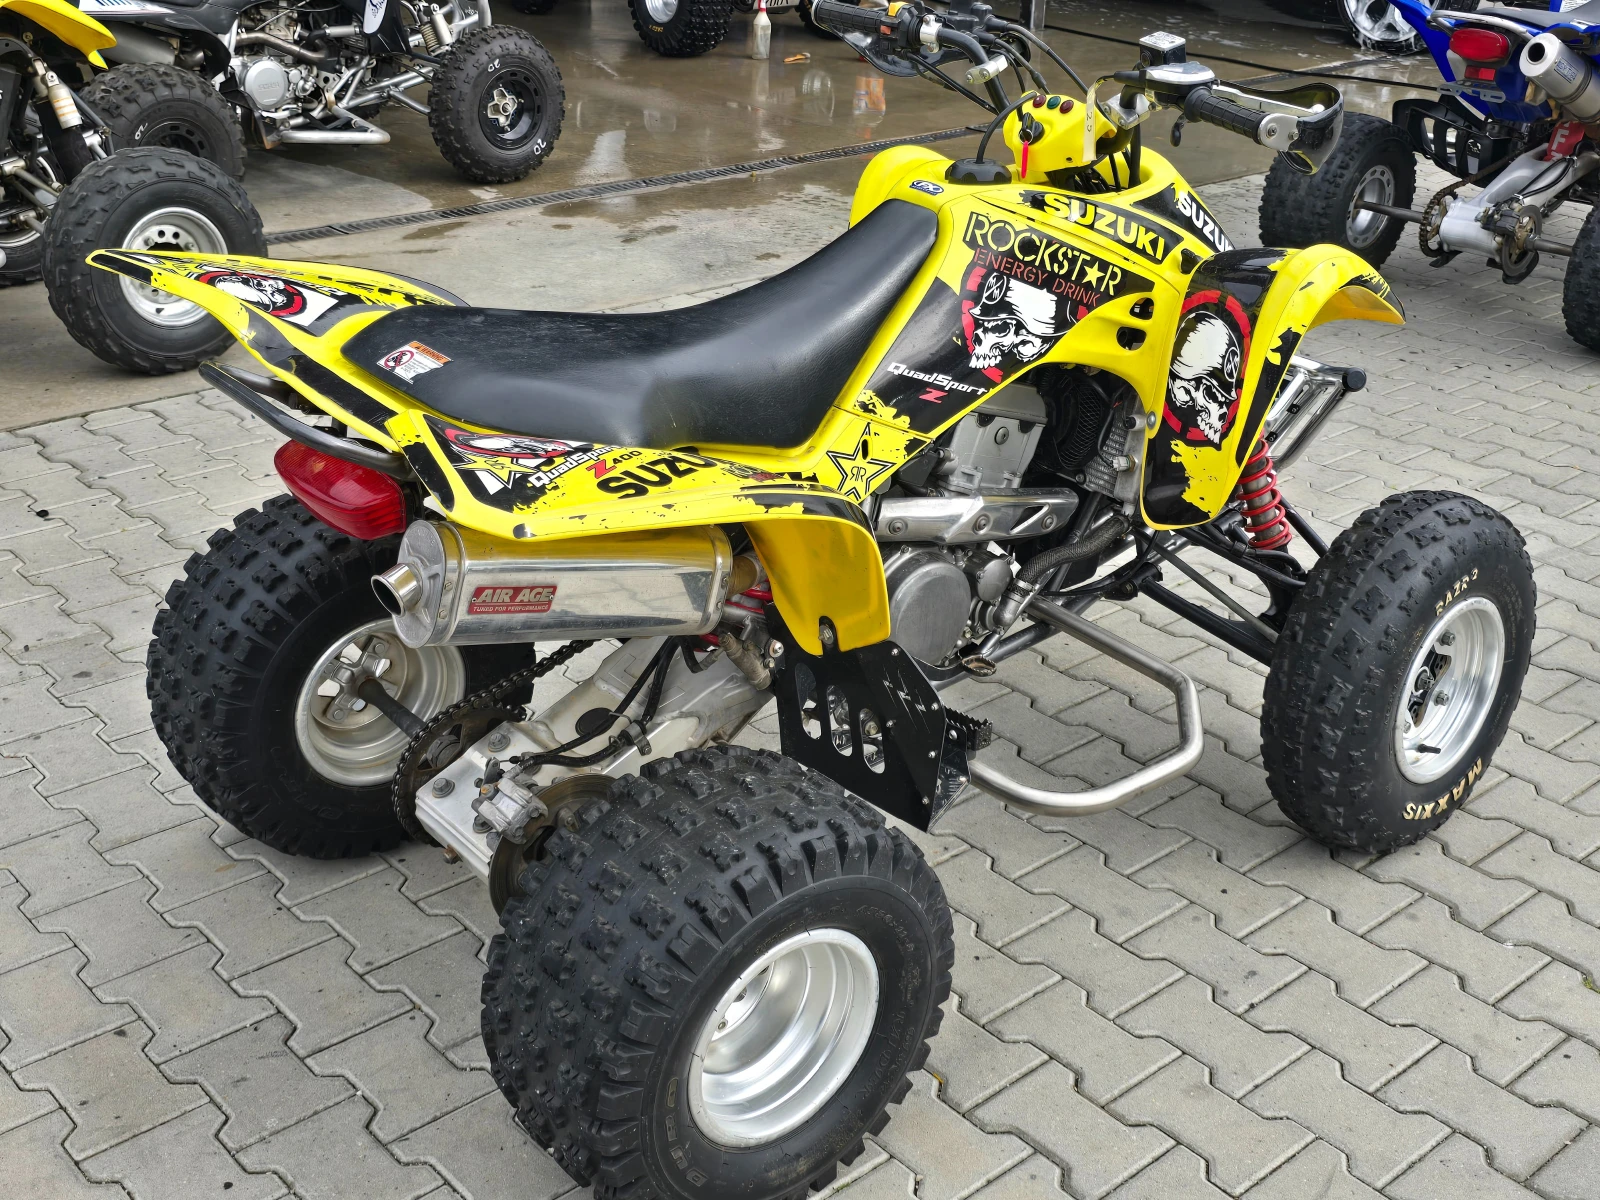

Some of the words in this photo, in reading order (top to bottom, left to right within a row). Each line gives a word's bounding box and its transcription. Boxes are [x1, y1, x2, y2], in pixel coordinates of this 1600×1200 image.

[533, 138, 547, 155] 20
[1043, 193, 1165, 261] SUZUKI
[973, 247, 1048, 286] ENERGY
[1052, 278, 1101, 307] DRINK
[887, 362, 988, 396] QuadSport
[918, 387, 948, 404] Z
[477, 588, 514, 603] AIR
[514, 587, 554, 602] AGE
[1435, 574, 1470, 617] RAZR
[1402, 756, 1483, 820] MAXXIS
[665, 1076, 709, 1188] DURO
